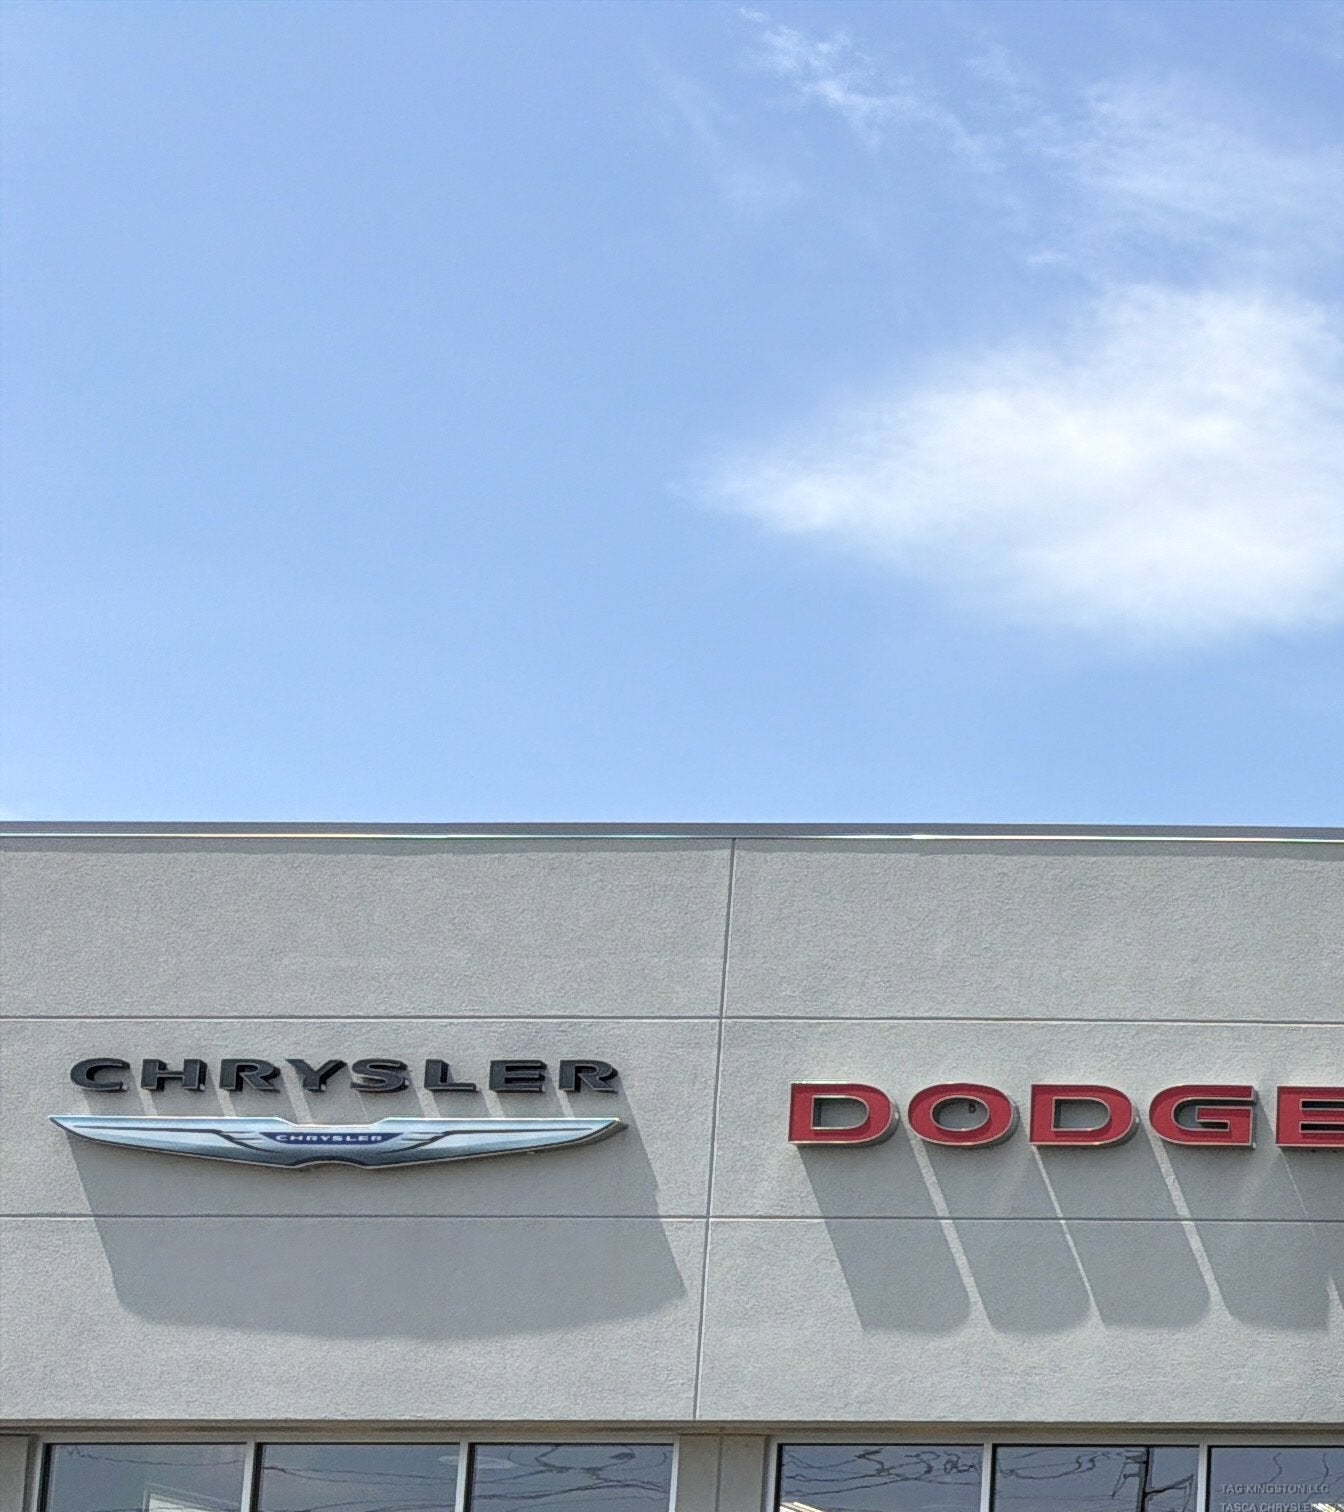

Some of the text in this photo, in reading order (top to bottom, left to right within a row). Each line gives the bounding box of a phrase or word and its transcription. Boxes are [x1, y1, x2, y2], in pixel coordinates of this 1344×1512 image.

[69, 1057, 619, 1093] CHRYSLER
[275, 1134, 383, 1143] CHRYSLER
[1221, 1484, 1329, 1495] TAG KINGSTON LLC
[1219, 1502, 1257, 1512] TASCA
[1259, 1502, 1318, 1512] CHRYSLE
